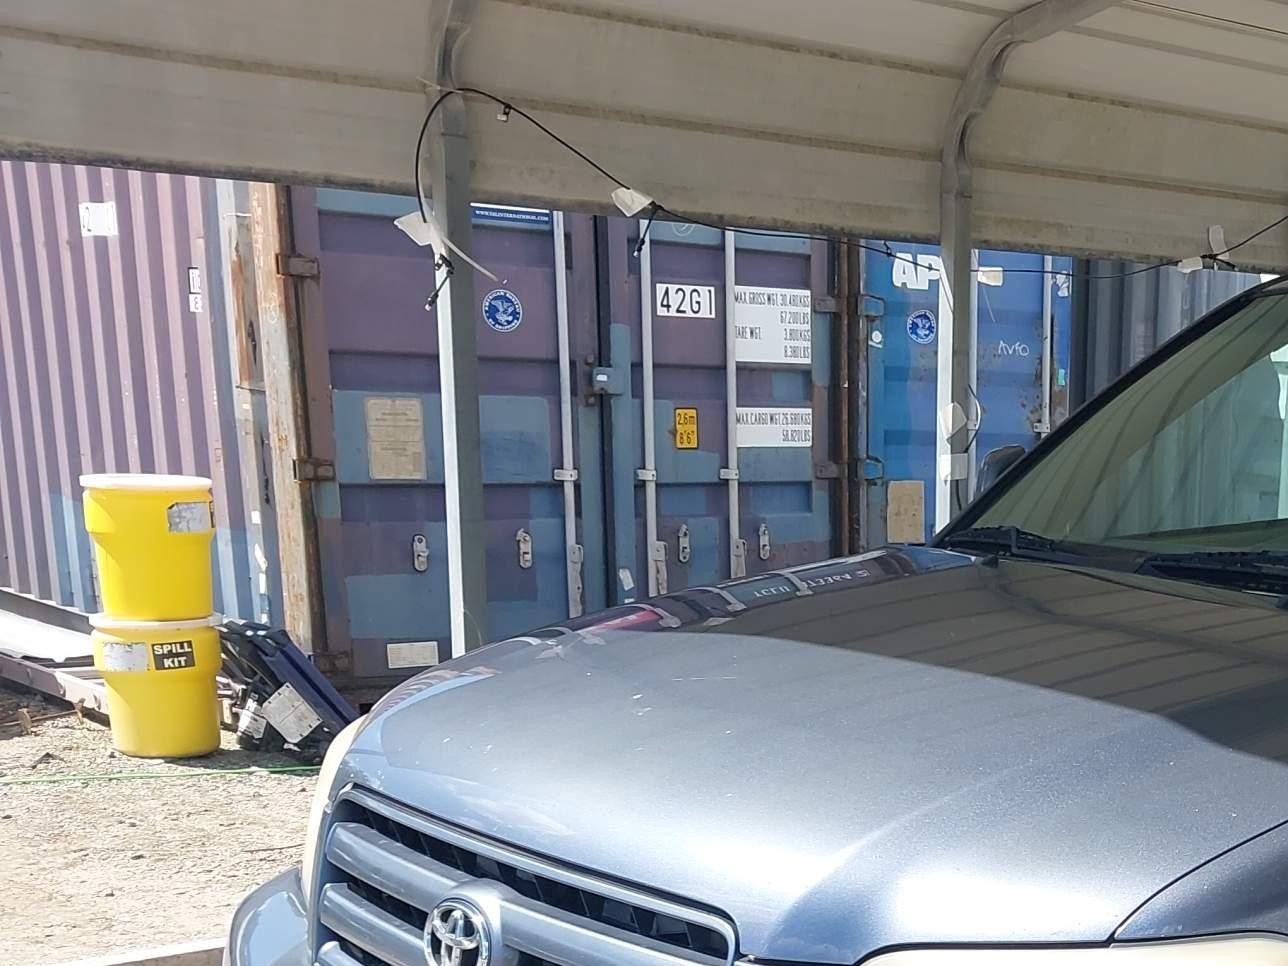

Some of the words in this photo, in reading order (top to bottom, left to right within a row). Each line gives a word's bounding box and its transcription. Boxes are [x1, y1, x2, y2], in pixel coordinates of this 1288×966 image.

[660, 286, 713, 316] 42G1
[153, 643, 192, 655] SPILL
[163, 657, 187, 668] KIT
